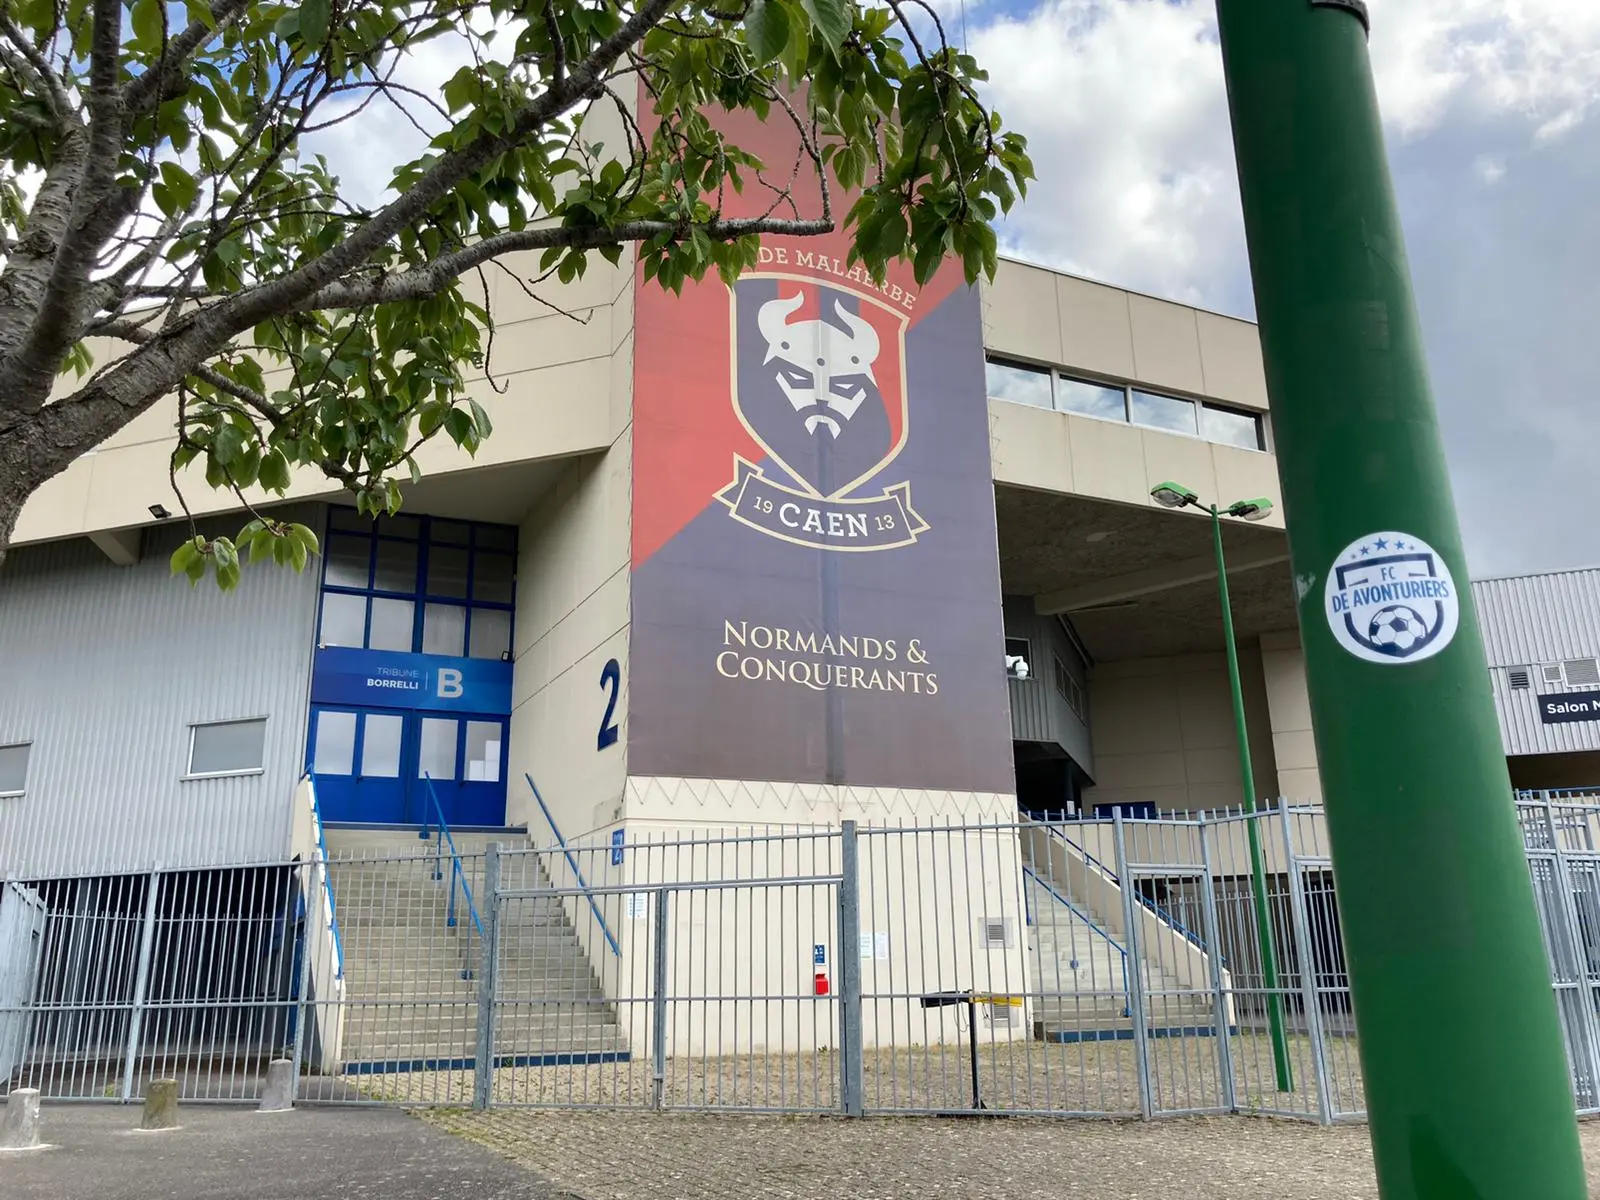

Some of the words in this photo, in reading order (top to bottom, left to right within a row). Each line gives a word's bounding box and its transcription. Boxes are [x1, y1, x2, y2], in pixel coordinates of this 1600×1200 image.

[758, 246, 788, 264] DE
[753, 496, 773, 514] 19
[779, 503, 868, 537] CAEN
[874, 514, 896, 531] 13
[1381, 566, 1396, 581] FC
[1332, 592, 1350, 613] DE
[1353, 580, 1449, 608] AVONTURIERS
[907, 638, 930, 665] &
[376, 666, 419, 678] TRIBUNE
[437, 667, 464, 698] B
[366, 678, 419, 690] BORRELLI
[597, 658, 620, 752] 2
[1546, 701, 1589, 714] Salon
